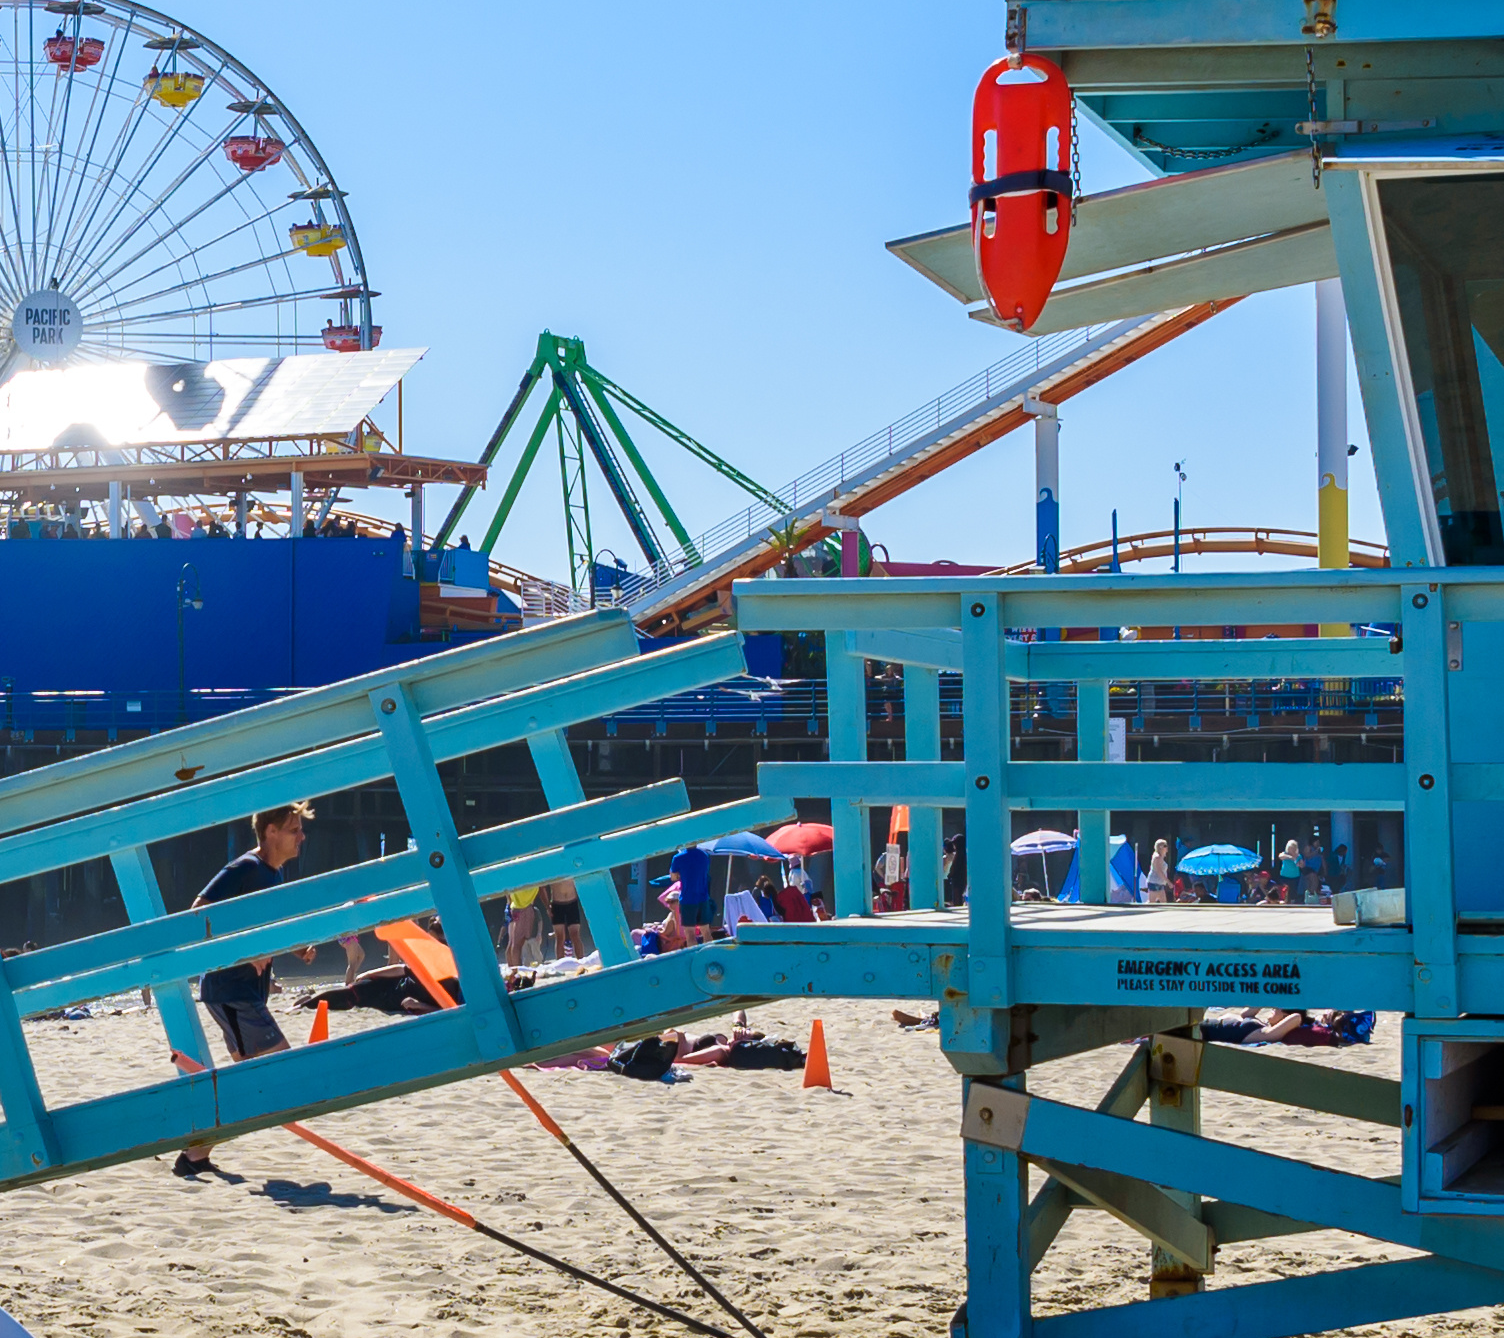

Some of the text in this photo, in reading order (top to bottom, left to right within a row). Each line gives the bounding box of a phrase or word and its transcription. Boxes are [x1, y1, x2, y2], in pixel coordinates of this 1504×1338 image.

[25, 307, 71, 326] PACIFIC
[32, 327, 64, 345] PARK
[1117, 959, 1301, 979] EMERGENCY ACCESS AREA
[1117, 978, 1301, 995] PLEASE STAY OUTSIDE THE CONES
